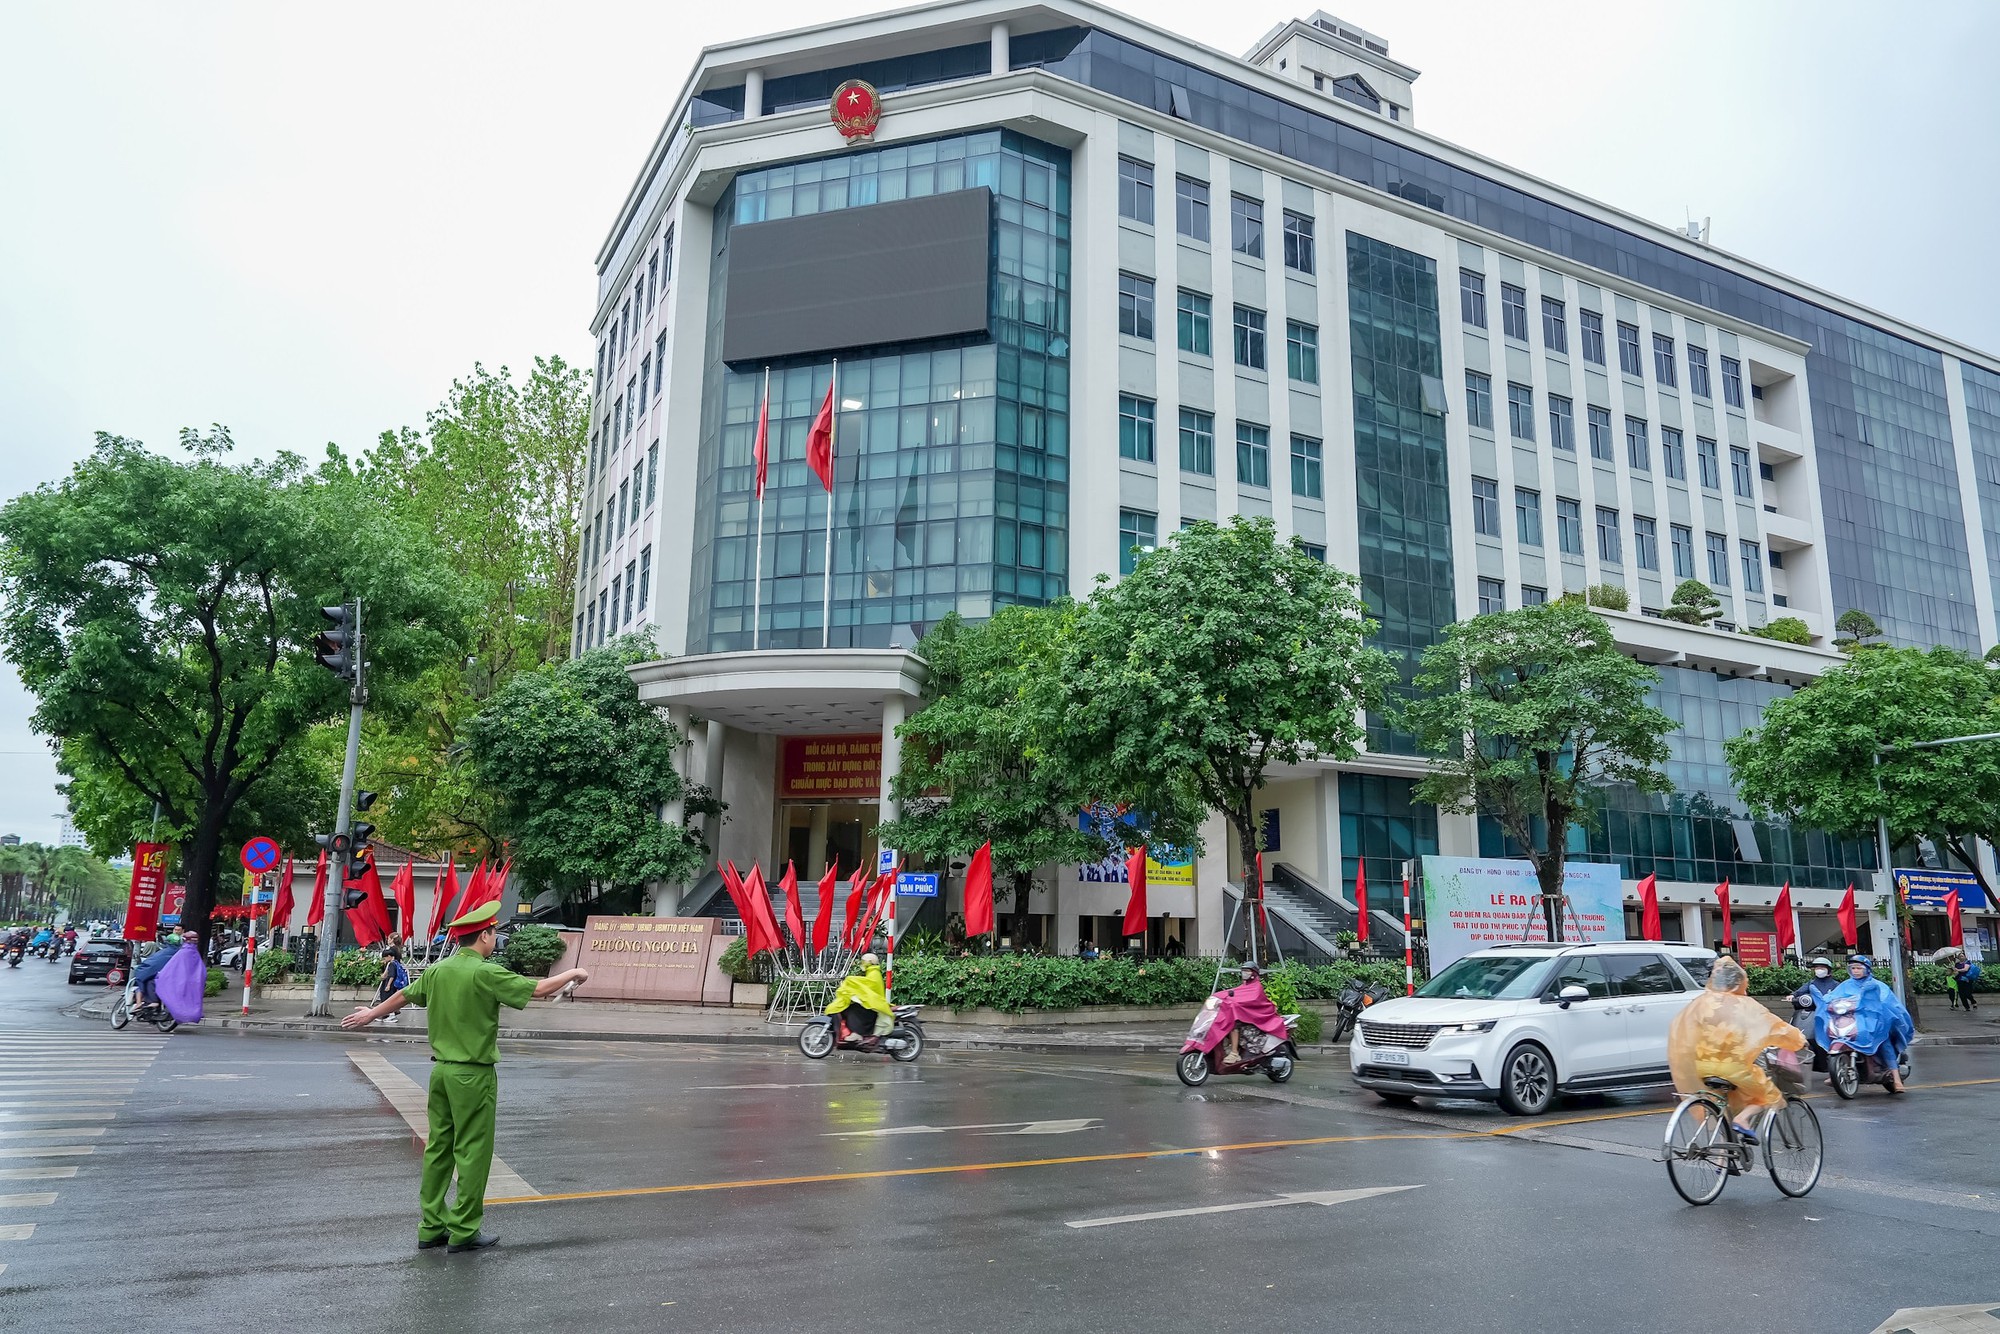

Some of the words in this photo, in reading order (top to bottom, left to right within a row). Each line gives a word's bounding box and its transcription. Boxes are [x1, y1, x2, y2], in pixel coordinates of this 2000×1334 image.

[871, 740, 882, 754] VIÊ
[803, 762, 826, 772] TRONG
[827, 760, 840, 772] XÂY
[842, 761, 862, 773] DỰNG
[900, 884, 914, 894] VẠN
[915, 882, 933, 892] PHÚC
[1490, 891, 1505, 905] LỄ
[1510, 895, 1526, 906] RA
[690, 924, 704, 932] NAM
[591, 936, 641, 952] PHƯỜNG
[643, 940, 679, 956] NGỌC
[681, 938, 698, 953] HÀ
